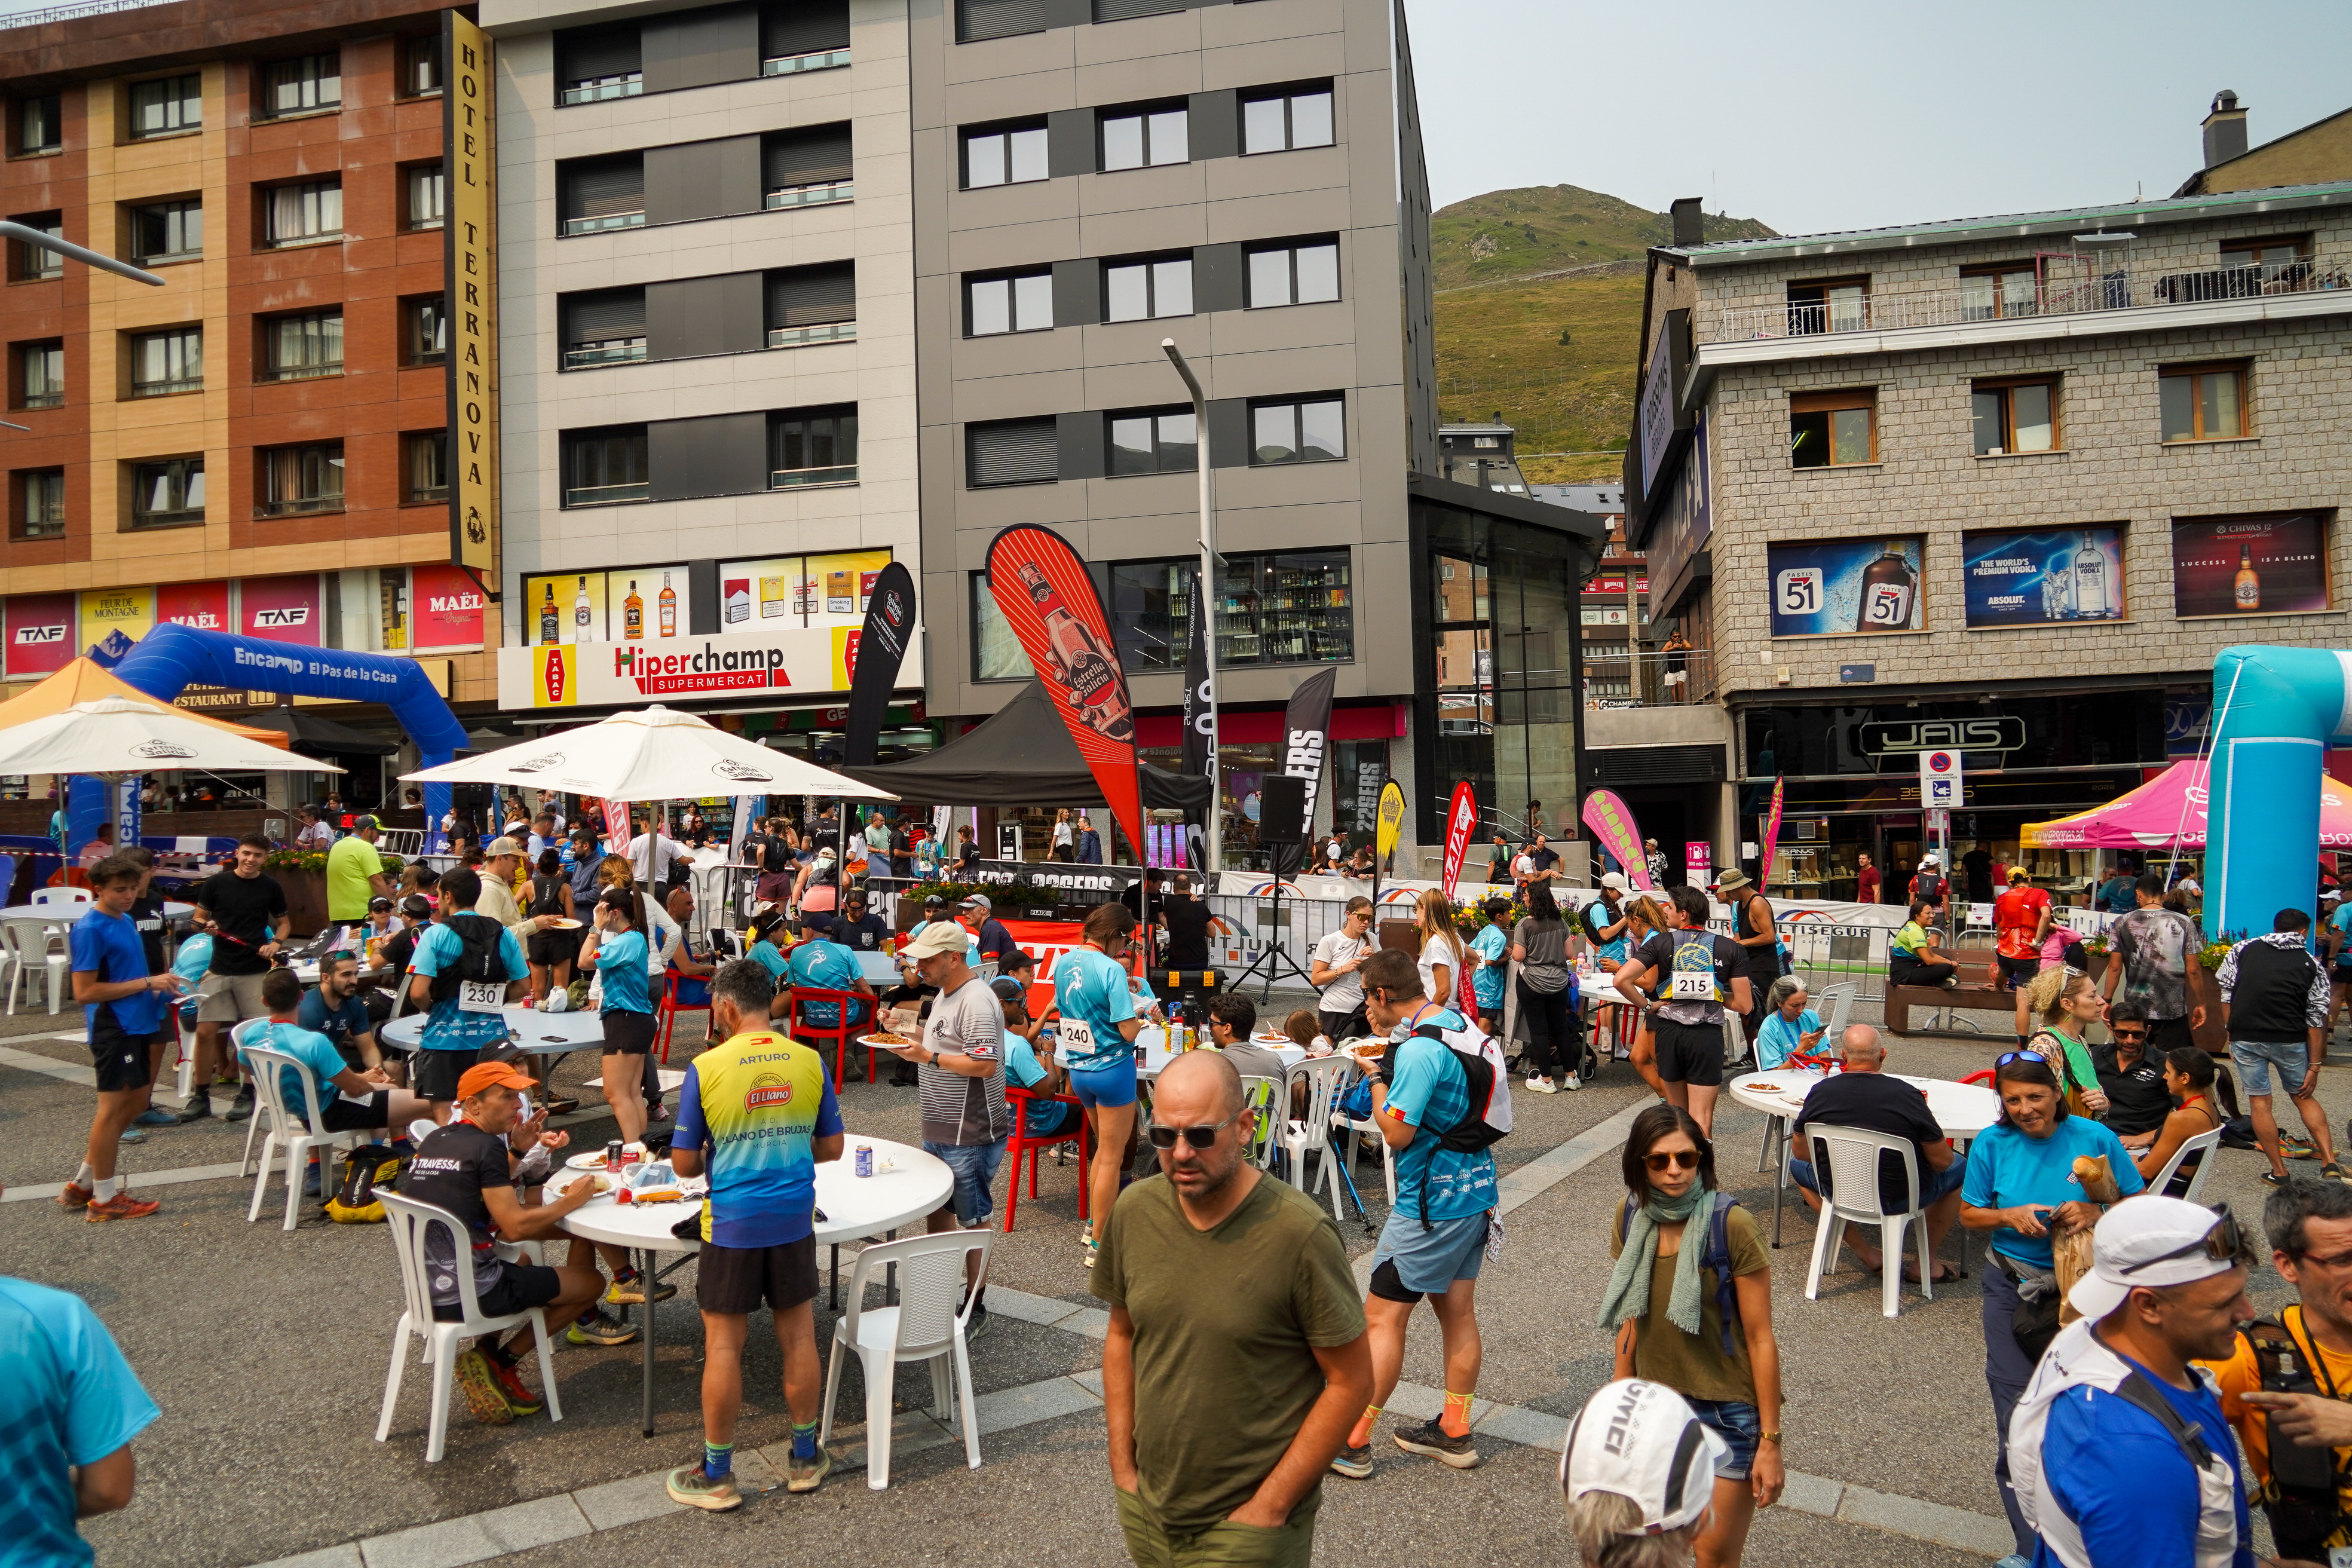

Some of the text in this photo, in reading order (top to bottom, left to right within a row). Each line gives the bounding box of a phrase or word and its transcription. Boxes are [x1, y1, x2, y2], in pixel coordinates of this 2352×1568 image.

[461, 42, 477, 188] HOTEL
[464, 221, 483, 486] TERRANOVA
[1671, 434, 1704, 558] ALFA
[2229, 523, 2261, 532] CHIVAS
[1973, 565, 2037, 576] PREMIUM VODKA
[1980, 558, 2029, 568] THE WORLD'S
[1604, 581, 1624, 590] BROOKLYN
[100, 598, 133, 608] FLEUR DE
[430, 592, 483, 612] MAËL
[1786, 582, 1814, 610] 51
[94, 607, 139, 618] MONTAGNE
[886, 601, 900, 623] Galicia
[887, 593, 903, 617] Estrella
[1872, 595, 1900, 621] 51
[259, 608, 305, 625] TAF
[443, 612, 471, 626] Original
[20, 626, 63, 642] TAF
[234, 647, 397, 684] Encamp El Pas de la Casa
[614, 642, 784, 695] Hiperchamp
[658, 674, 764, 690] SUPERMERCAT
[1073, 662, 1105, 690] Estrella
[1882, 721, 2002, 751] JAIS
[2031, 825, 2086, 846] www.gasopas.ad
[1679, 979, 1707, 993] 215
[467, 988, 495, 1004] 230
[1067, 1027, 1088, 1044] 240
[739, 1052, 791, 1066] ARTURO
[754, 1075, 781, 1086] frutos secos
[751, 1090, 789, 1104] El Llano
[758, 1129, 774, 1139] DE
[778, 1125, 811, 1137] BRUJAS
[753, 1140, 787, 1150] MURCIA
[417, 1158, 461, 1171] TRAVESSA
